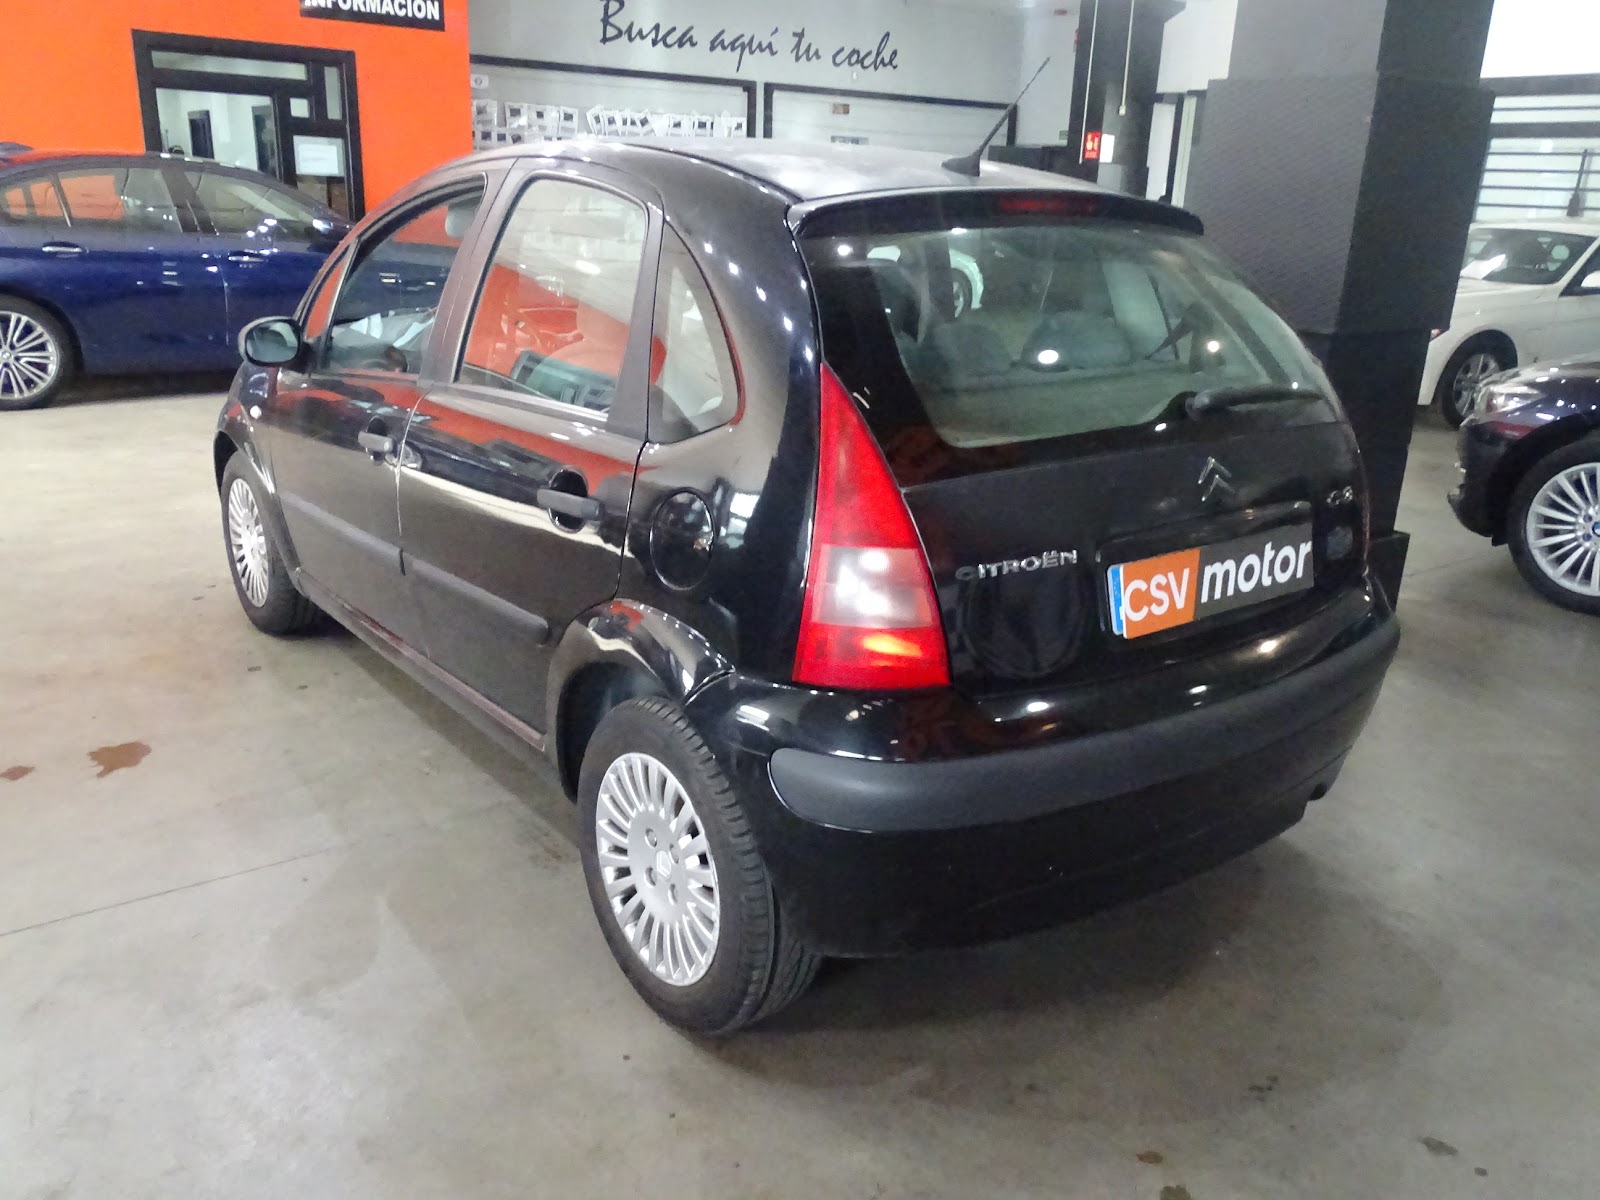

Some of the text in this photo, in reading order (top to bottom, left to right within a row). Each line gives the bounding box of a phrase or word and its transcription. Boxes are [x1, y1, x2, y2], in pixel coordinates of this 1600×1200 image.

[600, 0, 898, 72] Busca aquí tu coche
[955, 549, 1078, 580] CITROËN
[1124, 541, 1312, 622] CSV motor
